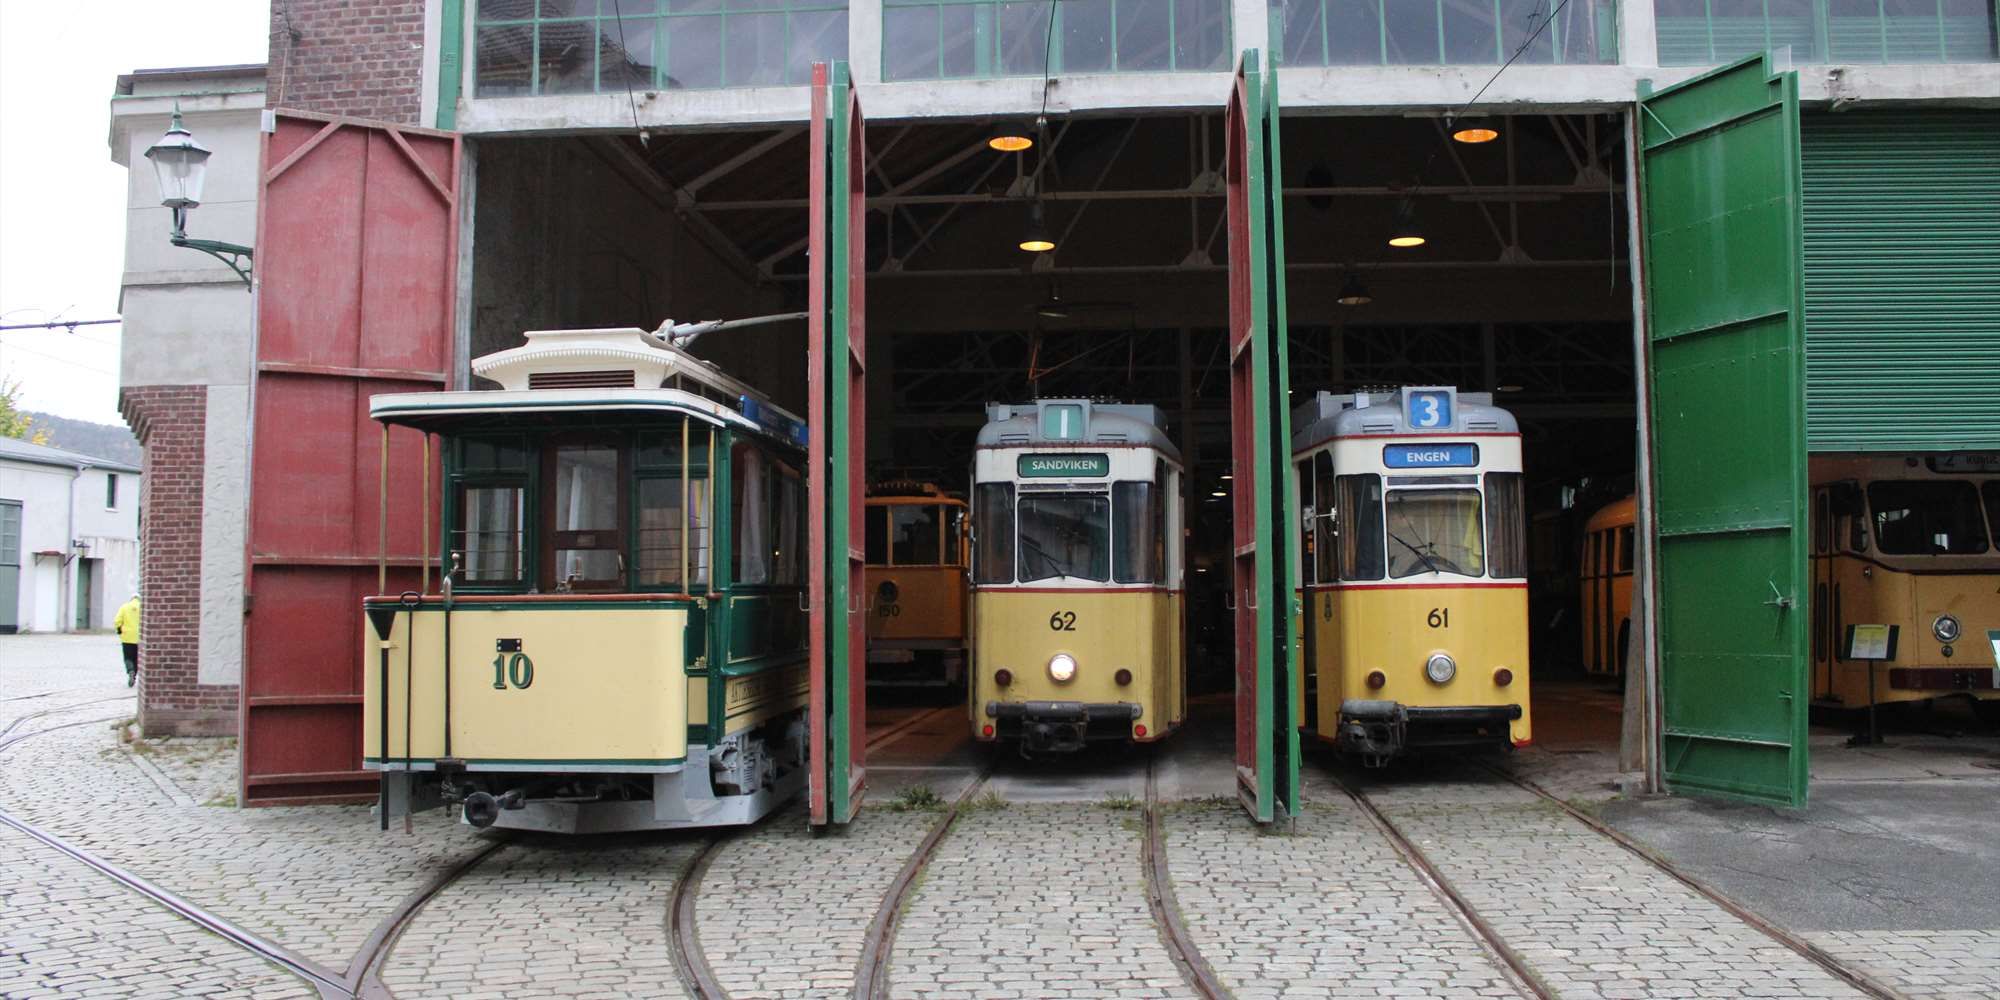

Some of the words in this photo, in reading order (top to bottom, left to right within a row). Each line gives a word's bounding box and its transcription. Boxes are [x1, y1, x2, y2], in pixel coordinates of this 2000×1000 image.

[1420, 395, 1440, 427] 3
[1061, 409, 1069, 438] 1
[1032, 460, 1098, 471] SANDVIKEN
[1406, 451, 1450, 463] ENGEN
[1050, 611, 1076, 631] 62
[1427, 608, 1449, 628] 61
[493, 653, 534, 690] 10
